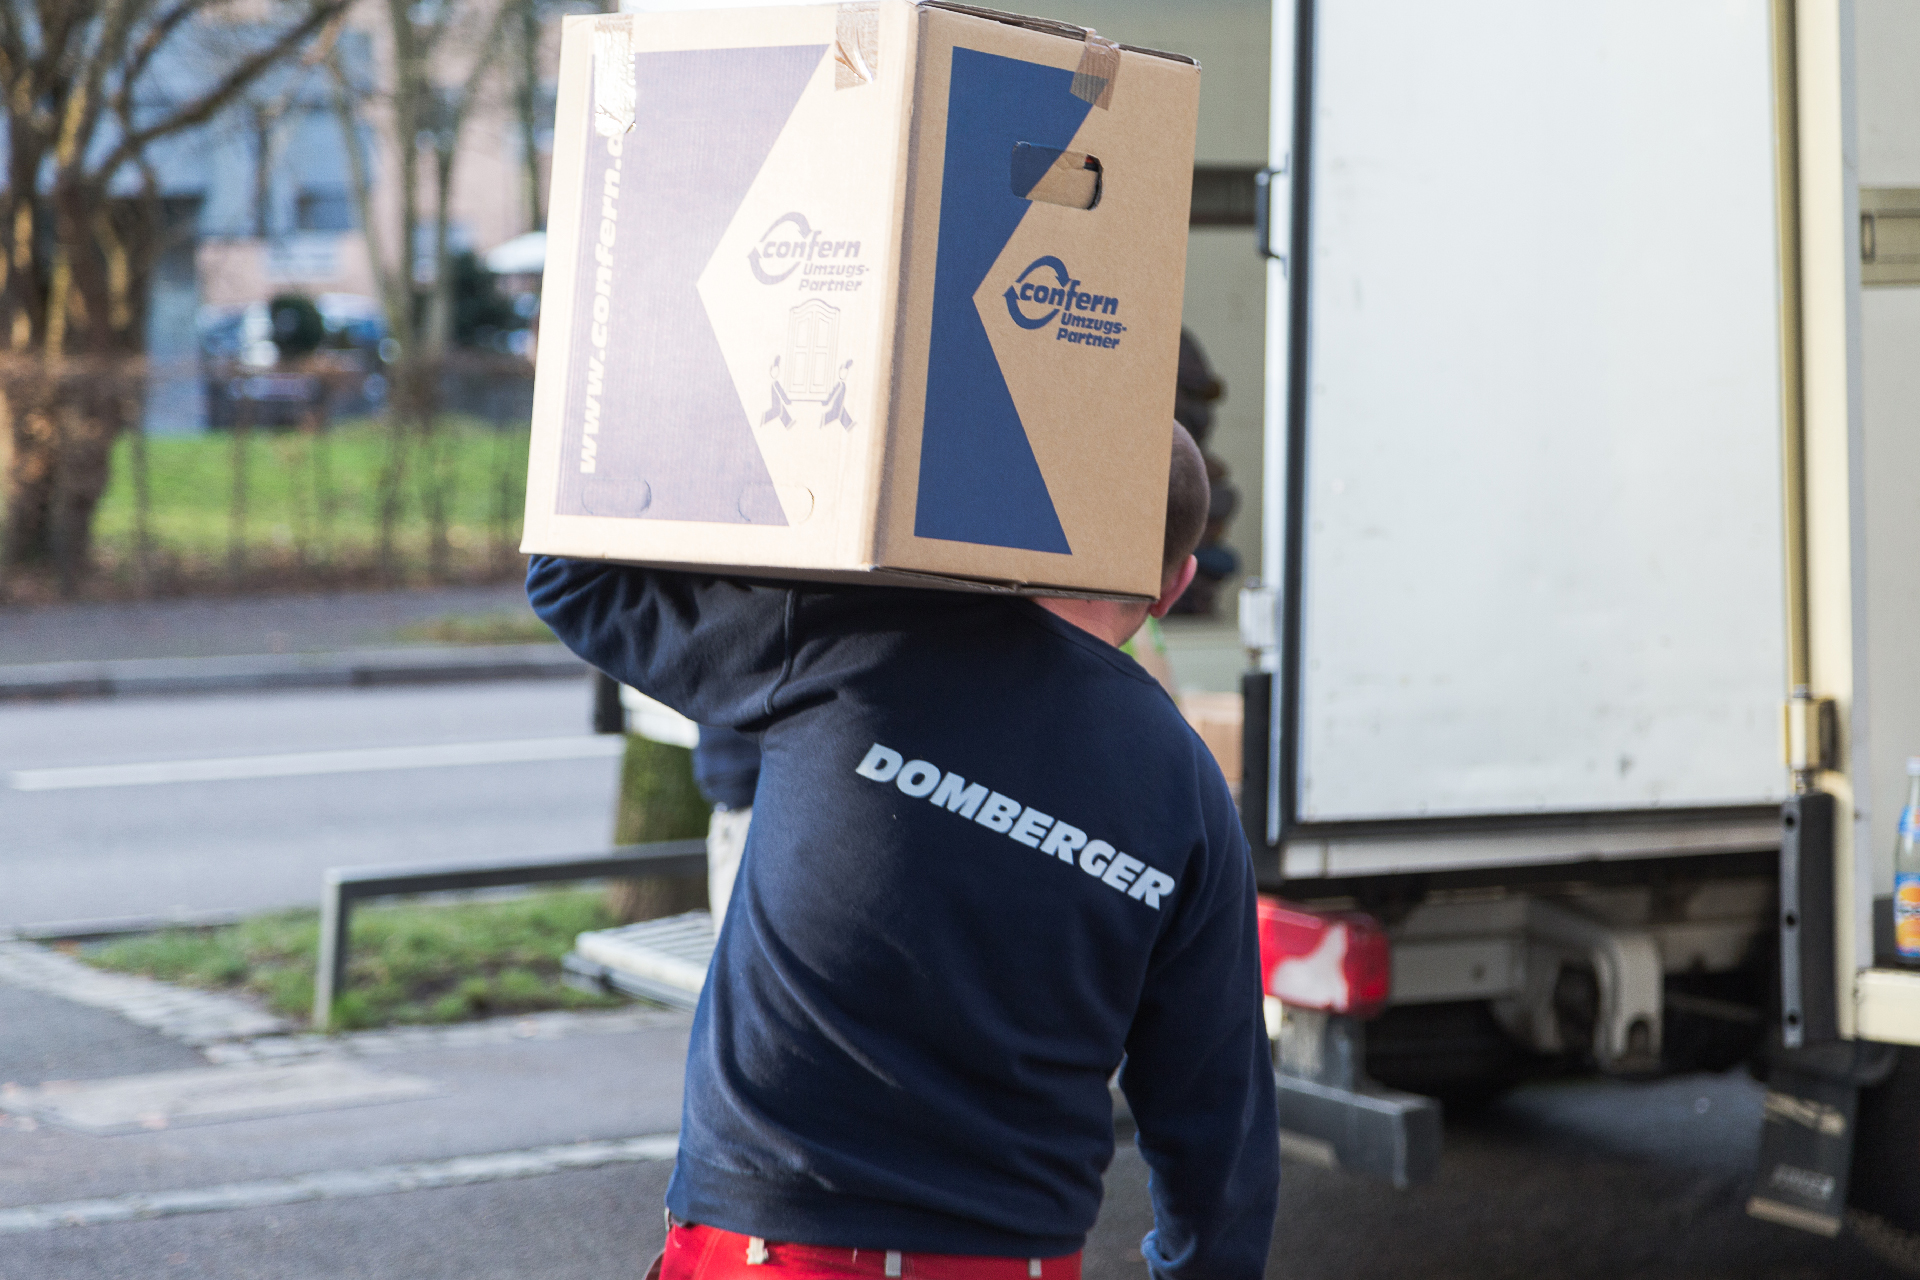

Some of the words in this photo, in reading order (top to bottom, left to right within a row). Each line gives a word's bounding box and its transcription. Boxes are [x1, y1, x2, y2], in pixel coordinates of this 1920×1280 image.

[762, 230, 862, 261] confern
[802, 263, 870, 278] Umzugs-
[798, 277, 863, 292] Partner
[1019, 279, 1119, 316] confern
[579, 133, 626, 474] www.confern.d
[1060, 313, 1127, 335] Umzugs-
[1056, 326, 1120, 350] Partner
[855, 742, 1175, 911] DOMBERGER
